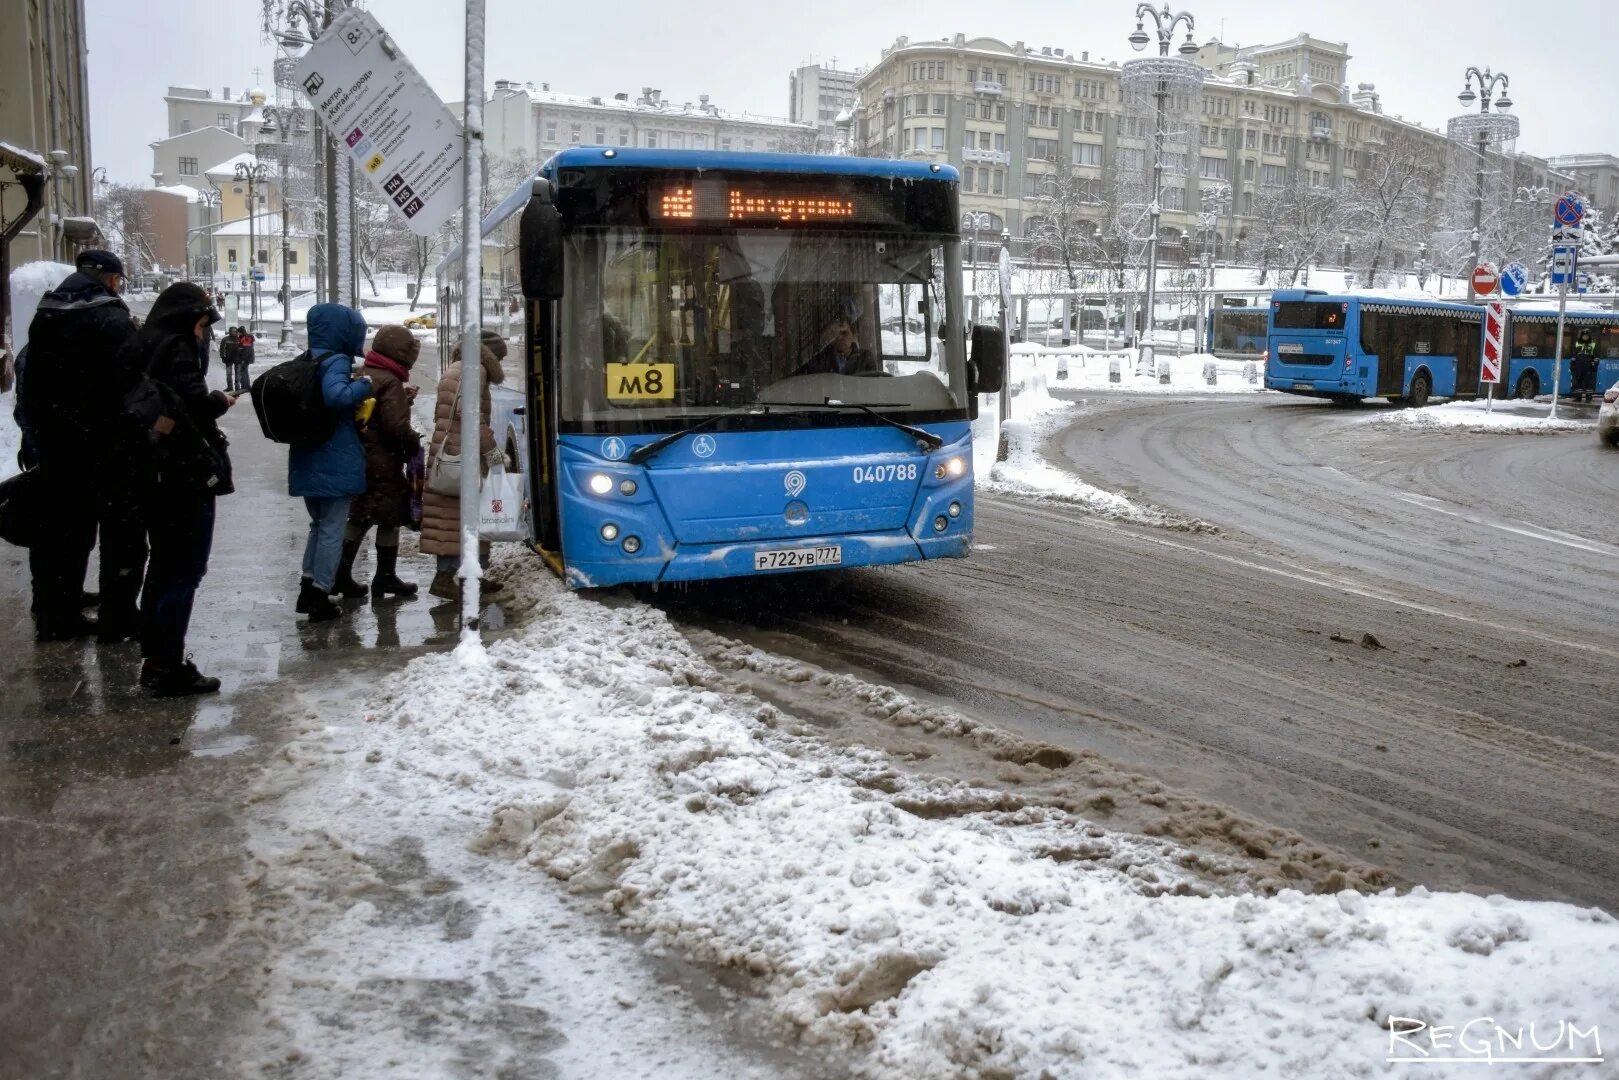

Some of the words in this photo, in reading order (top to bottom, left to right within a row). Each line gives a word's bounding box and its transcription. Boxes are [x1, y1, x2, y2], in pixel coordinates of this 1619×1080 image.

[320, 87, 342, 111] Метро
[327, 70, 373, 120] «Китай-город»
[619, 369, 663, 394] м8
[853, 464, 917, 483] 040788
